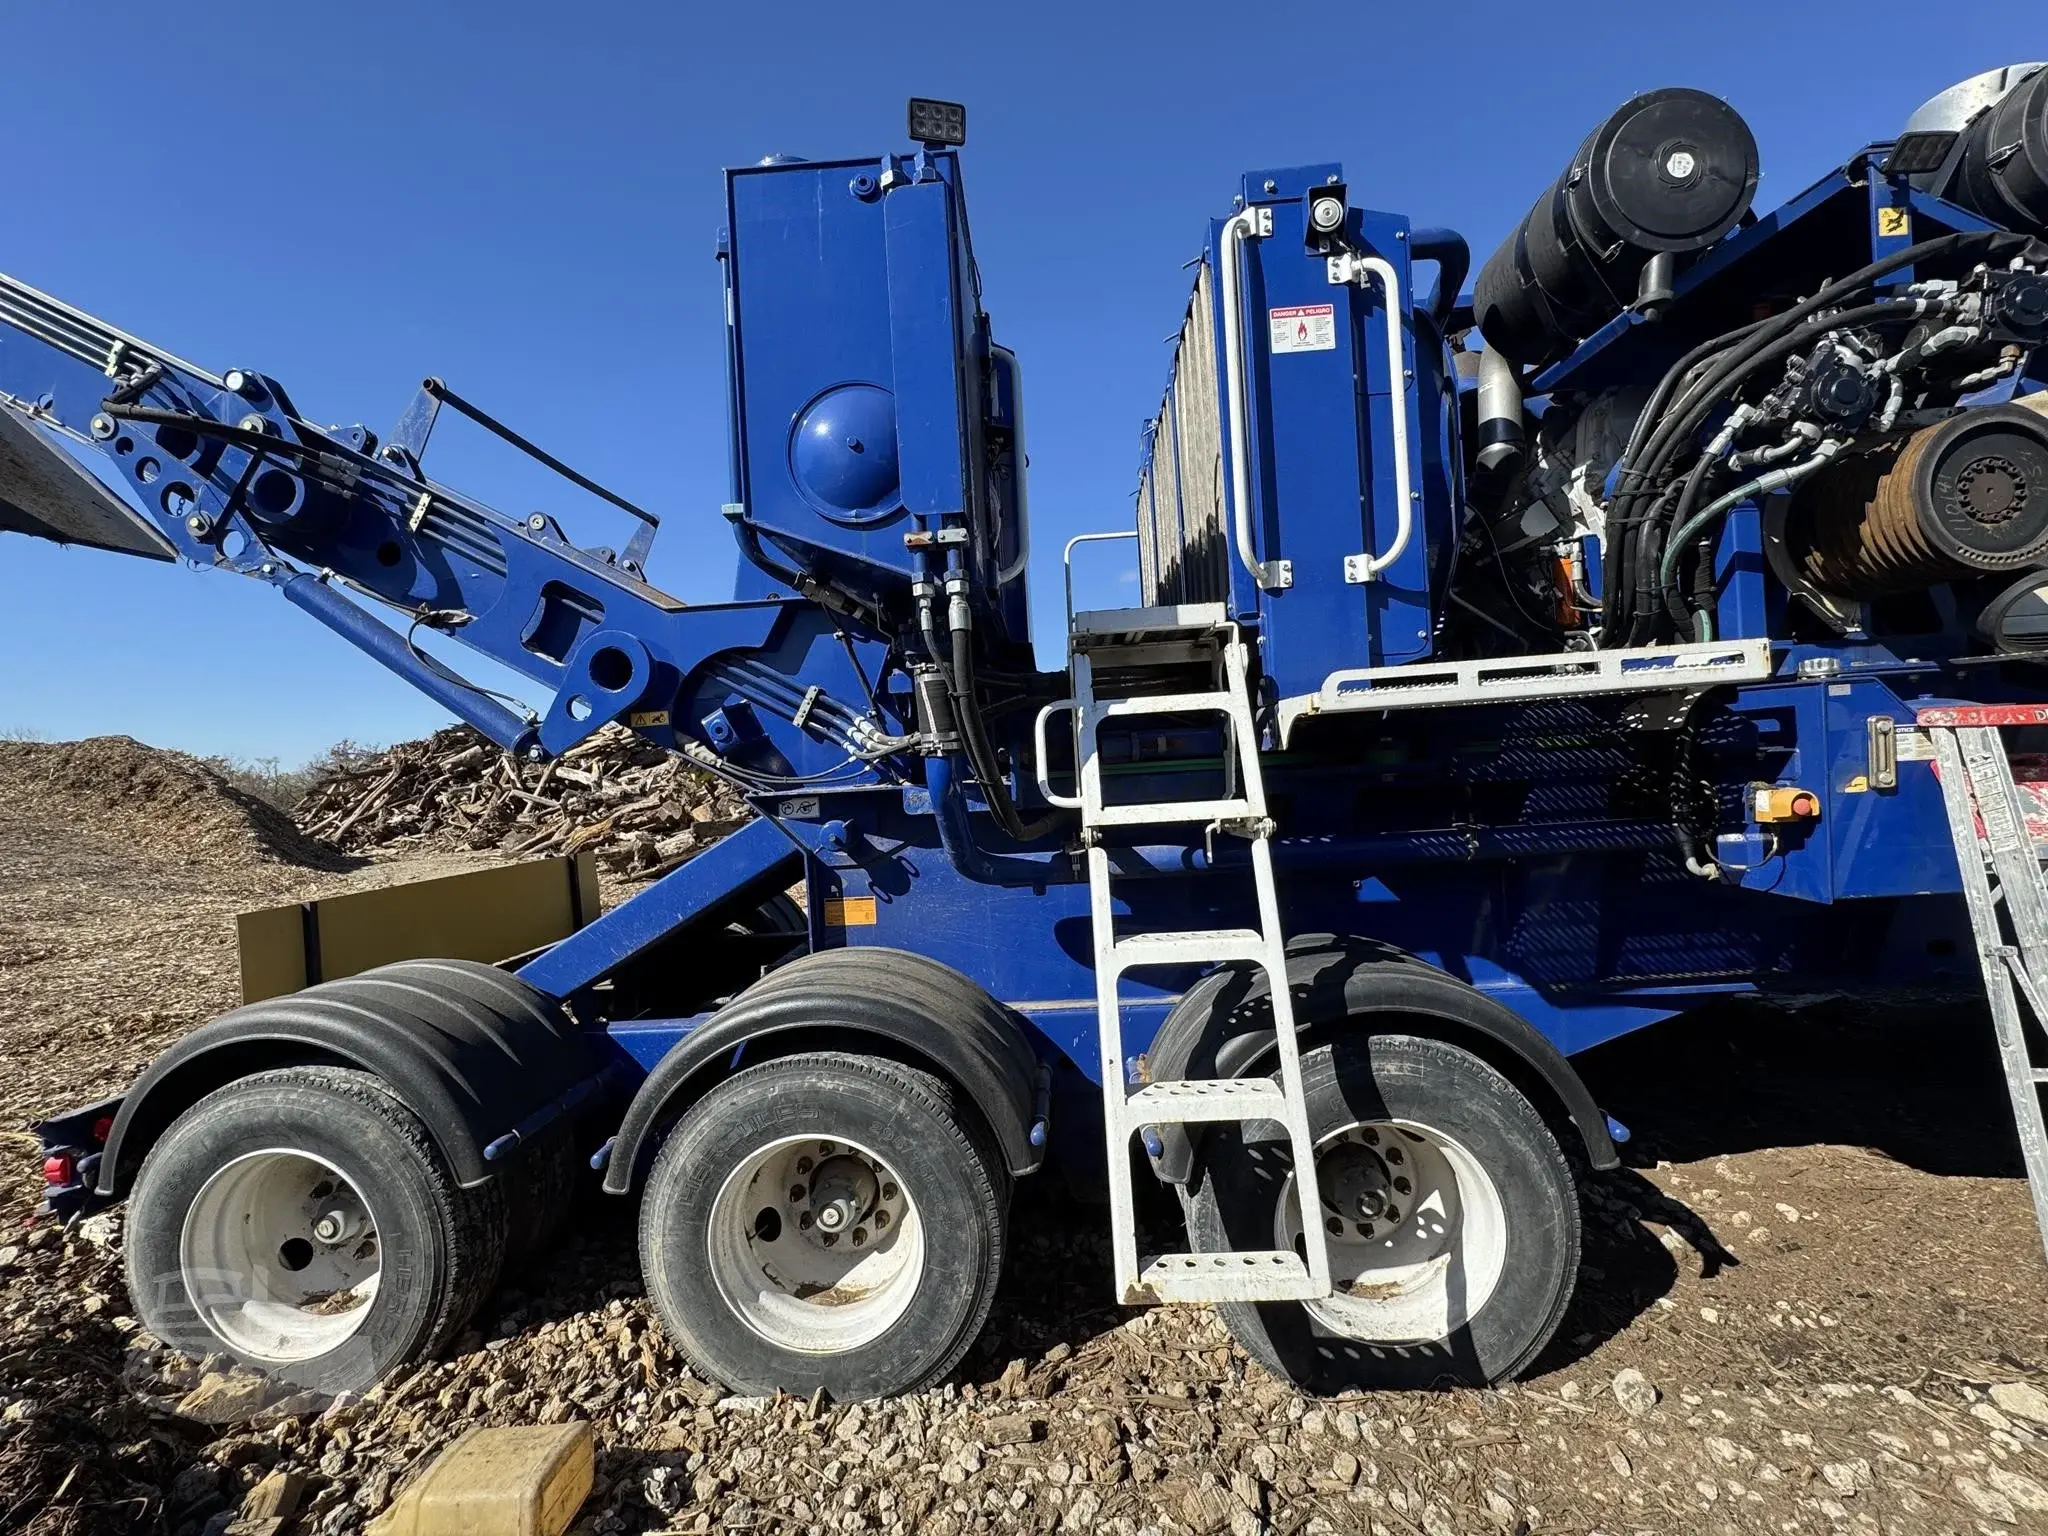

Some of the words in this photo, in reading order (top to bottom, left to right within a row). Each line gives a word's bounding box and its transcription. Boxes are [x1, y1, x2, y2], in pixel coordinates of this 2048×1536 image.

[1273, 310, 1297, 318] DANGER
[1305, 307, 1331, 316] PELIGRO
[679, 1103, 820, 1207] HERCULES
